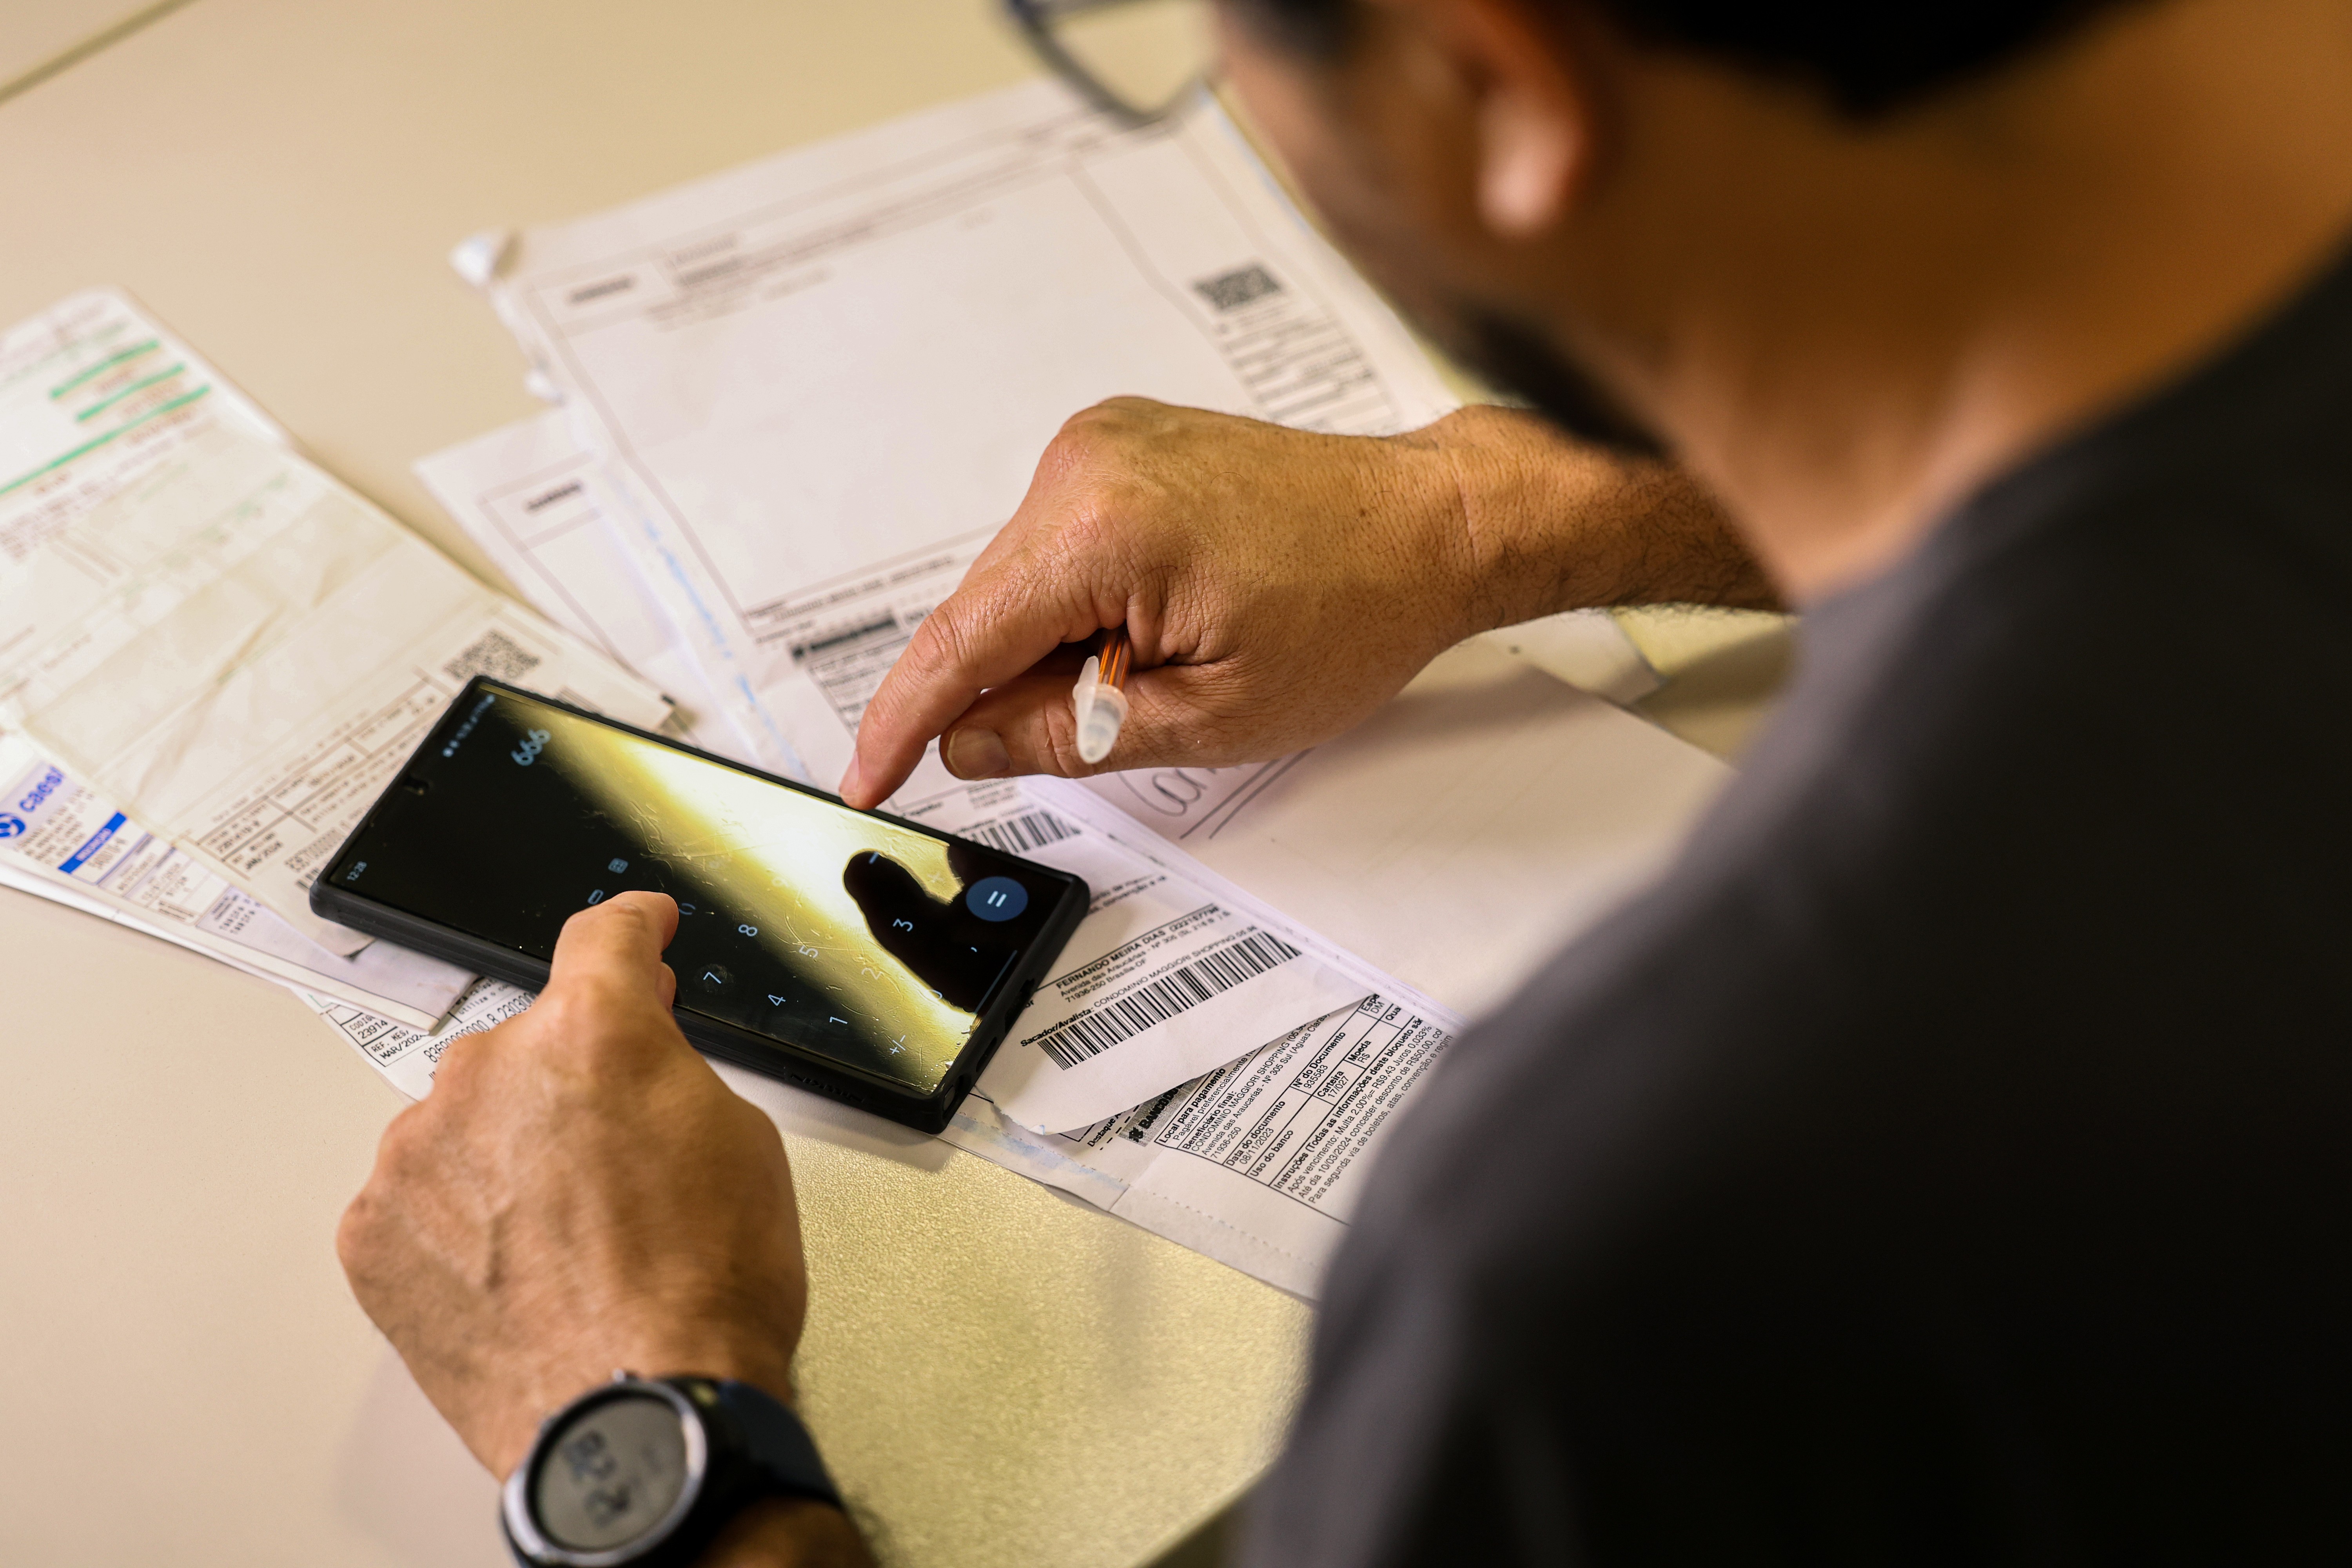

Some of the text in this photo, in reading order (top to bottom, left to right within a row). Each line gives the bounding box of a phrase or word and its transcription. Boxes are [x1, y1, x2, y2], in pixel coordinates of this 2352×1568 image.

[511, 728, 551, 766] 666
[738, 924, 758, 937] 8
[892, 918, 914, 932] 3
[799, 944, 818, 958] 5
[1056, 959, 1109, 989] FERNANDO
[1111, 942, 1141, 961] MEIRA
[1142, 930, 1165, 944] DIAS
[703, 972, 722, 984] 7
[1020, 1007, 1094, 1047] Sacador/Avalista:
[1094, 976, 1148, 1007] CONDOMINIO
[1149, 955, 1191, 978] MAGGIORI
[1192, 934, 1235, 957] SHOPPING
[1060, 980, 1091, 996] Avenida
[1092, 972, 1105, 981] das
[1065, 981, 1106, 1002] 71936-250
[768, 994, 786, 1006] 4
[1370, 1002, 1385, 1014] DM
[358, 1020, 388, 1039] 23914
[829, 1016, 848, 1025] 1
[371, 1041, 390, 1053] REF.
[1303, 1069, 1313, 1079] do
[1309, 1031, 1346, 1069] Documento
[1347, 1040, 1372, 1062] Moeda
[1357, 1053, 1370, 1063] R$
[1304, 1065, 1328, 1089] 935583
[1317, 1071, 1345, 1097] Carteira
[1328, 1075, 1349, 1098] 17/027
[1159, 1068, 1226, 1143] Local para pagamento
[1173, 1114, 1200, 1140] Pagável
[1198, 1058, 1248, 1114] preferencialmente
[1192, 1109, 1230, 1151] CONDOMINIO
[1228, 1074, 1260, 1108] MAGGIORI
[1257, 1042, 1289, 1074] SHOPPING
[1202, 1131, 1225, 1155] Avenida
[1224, 1120, 1236, 1130] das
[1234, 1087, 1263, 1118] Araucarias
[1270, 1063, 1283, 1076] 305
[1280, 1054, 1292, 1064] Sul
[1290, 1033, 1310, 1054] (Aguas
[1274, 1152, 1308, 1189] Instruções
[1305, 1128, 1329, 1152] (Todas
[1327, 1118, 1337, 1128] as
[1333, 1076, 1372, 1118] informações
[1370, 1057, 1388, 1075] deste
[1384, 1029, 1414, 1057] bloqueto
[1182, 1091, 1237, 1149] Beneficiário final:
[1287, 1175, 1305, 1193] Após
[1303, 1135, 1339, 1174] vencimento:
[1335, 1115, 1355, 1135] Multa
[1372, 1065, 1396, 1089] R$9,43
[1393, 1049, 1412, 1067] Juros
[1408, 1026, 1432, 1049] 0,033%
[1298, 1186, 1312, 1199] Até
[1310, 1174, 1321, 1186] dia
[1319, 1137, 1352, 1173] 10/03/2024
[1350, 1104, 1377, 1137] conceder
[1375, 1076, 1402, 1105] desconto
[1400, 1066, 1410, 1075] de
[1406, 1040, 1436, 1066] R$50,00,
[1087, 1118, 1116, 1147] Destaque
[1211, 1127, 1241, 1159] 71936-250
[1226, 1101, 1285, 1166] Data do documento
[1239, 1128, 1274, 1164] 08/11/2023
[1308, 1186, 1327, 1204] Para
[1324, 1158, 1351, 1187] segunda
[1348, 1147, 1360, 1157] via
[1357, 1136, 1367, 1146] de
[1363, 1111, 1390, 1137] boletos,
[1387, 1093, 1405, 1109] atas,
[1401, 1058, 1432, 1091] convenção
[1250, 1130, 1294, 1176] Uso do banco
